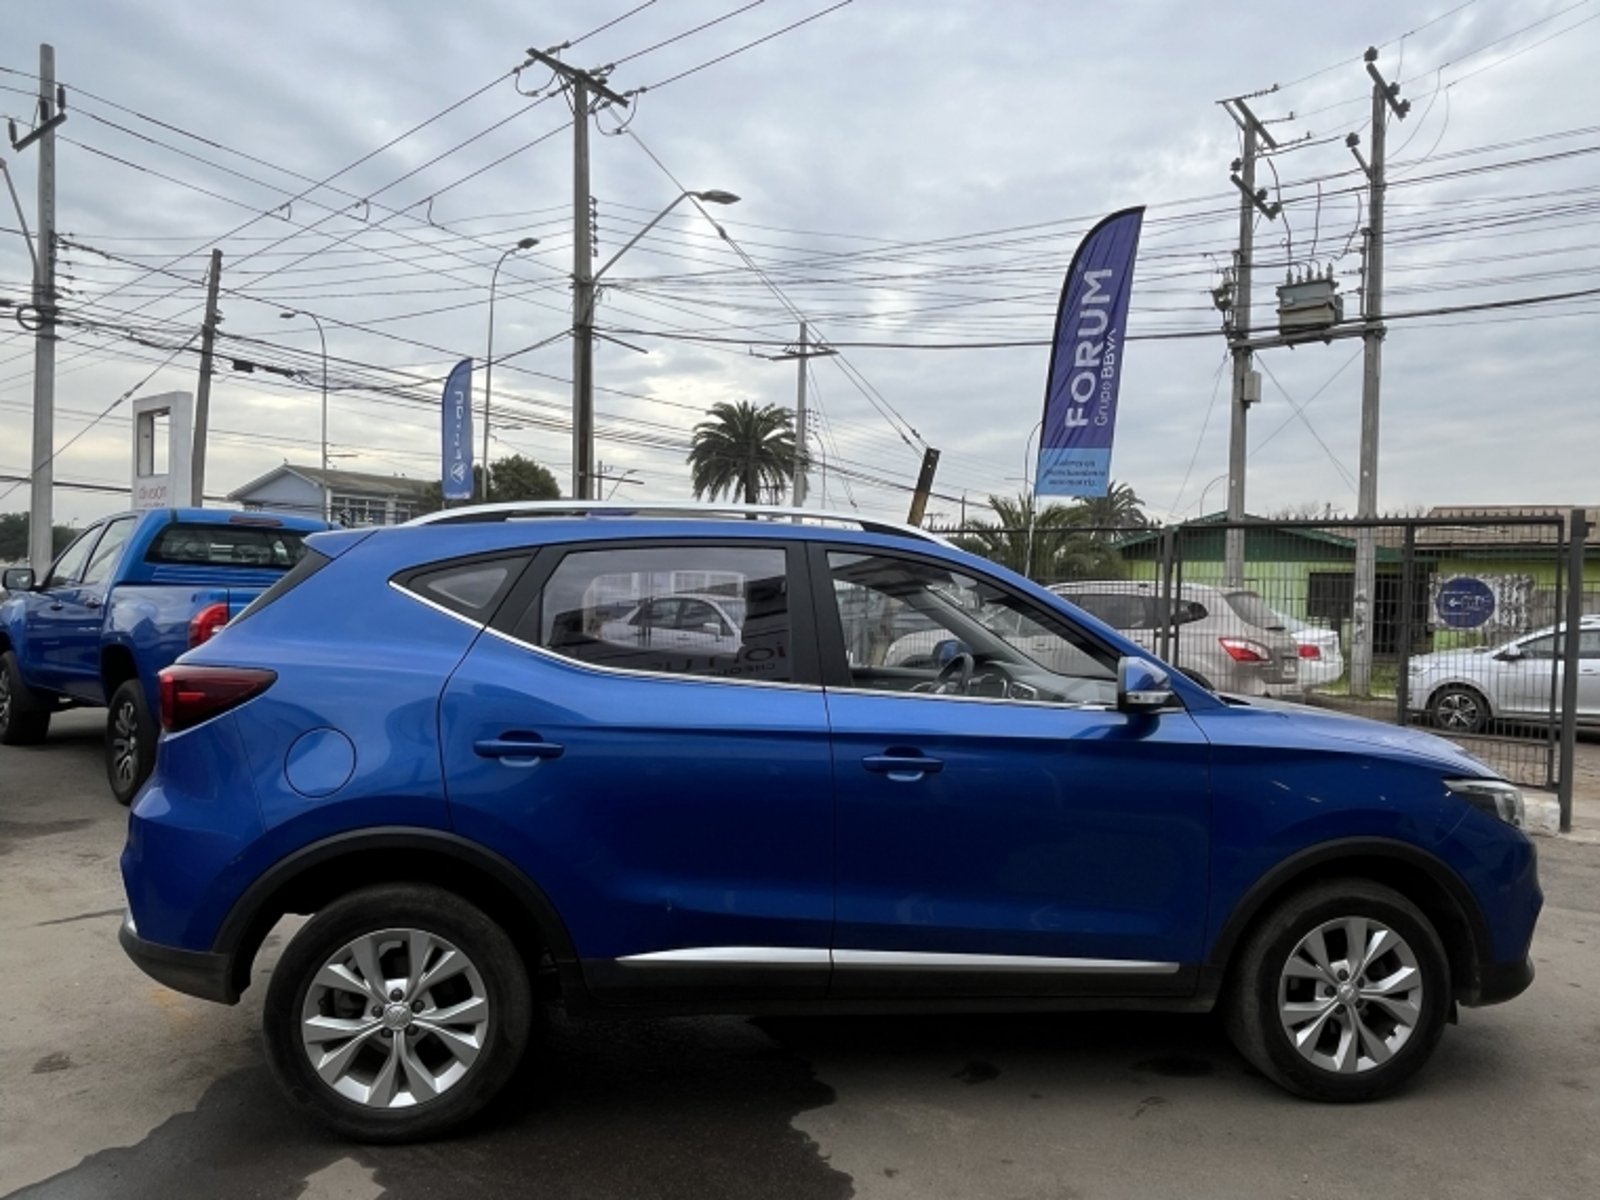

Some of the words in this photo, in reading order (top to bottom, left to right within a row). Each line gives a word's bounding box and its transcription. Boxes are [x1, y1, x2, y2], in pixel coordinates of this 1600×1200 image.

[1064, 267, 1113, 429] FORUM
[1101, 327, 1117, 379] BBVA
[1094, 382, 1113, 427] Grupo
